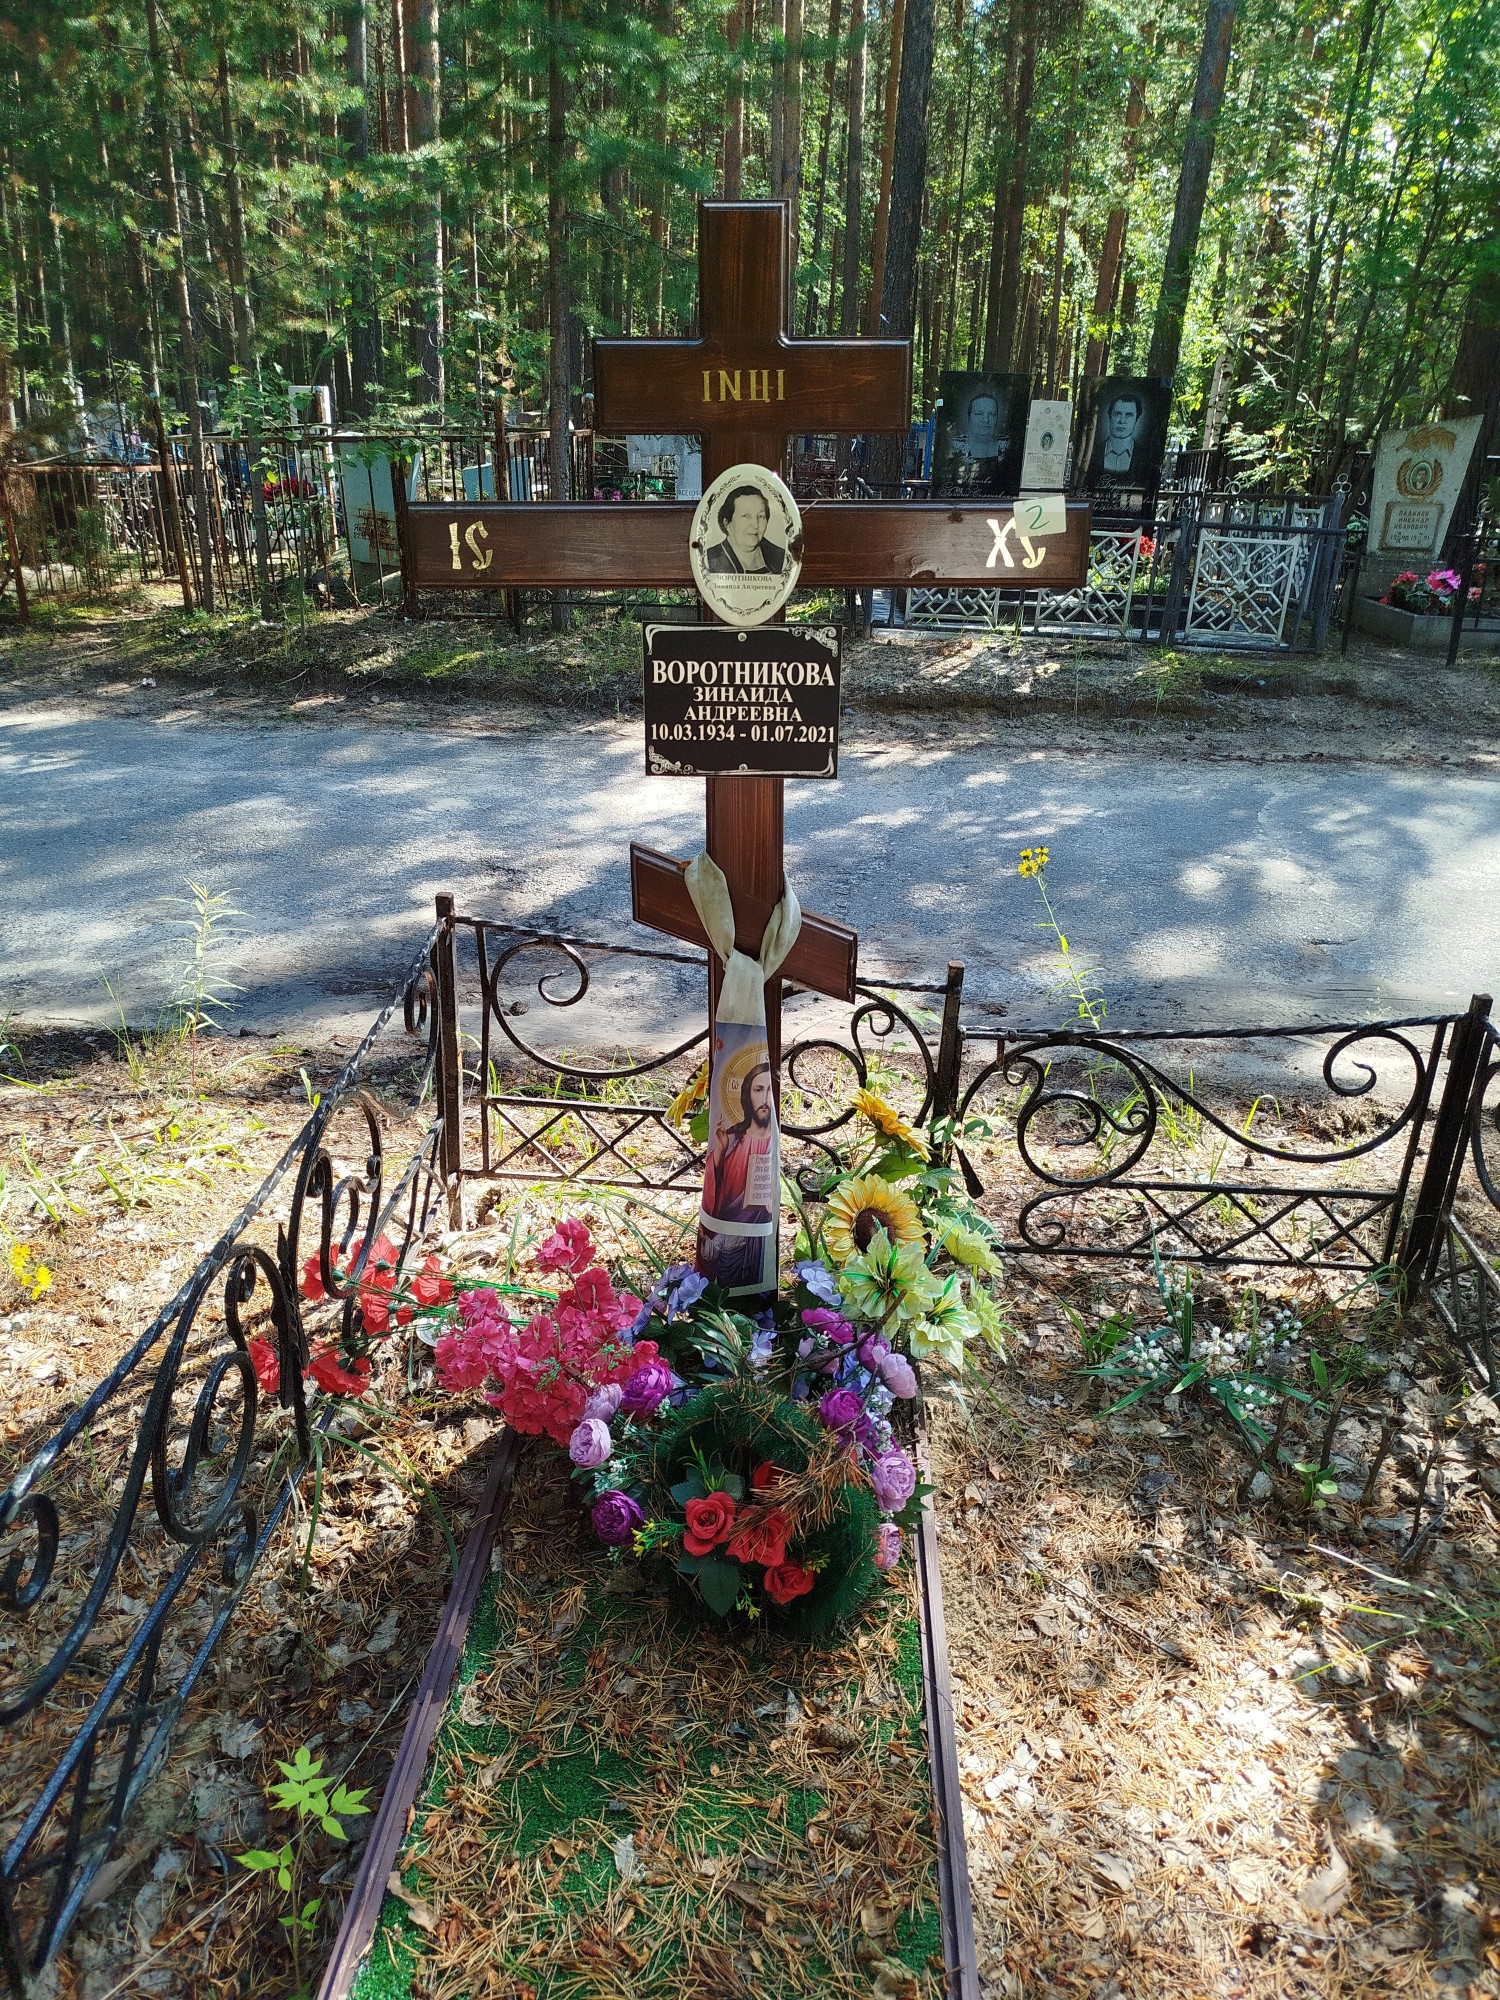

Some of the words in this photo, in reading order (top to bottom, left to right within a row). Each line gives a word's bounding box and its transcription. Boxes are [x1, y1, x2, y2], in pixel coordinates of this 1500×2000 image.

[1025, 504, 1050, 530] 2
[716, 574, 773, 582] ВОРОТНИКОВА
[741, 583, 776, 591] Андреевна
[652, 660, 836, 686] ВОРОТНИКОВА
[692, 686, 794, 705] ЗИНАИДА
[683, 705, 803, 724] АНДРЕЕВНА
[650, 723, 735, 741] 10.03.1934
[751, 724, 835, 743] 01.07.2021
